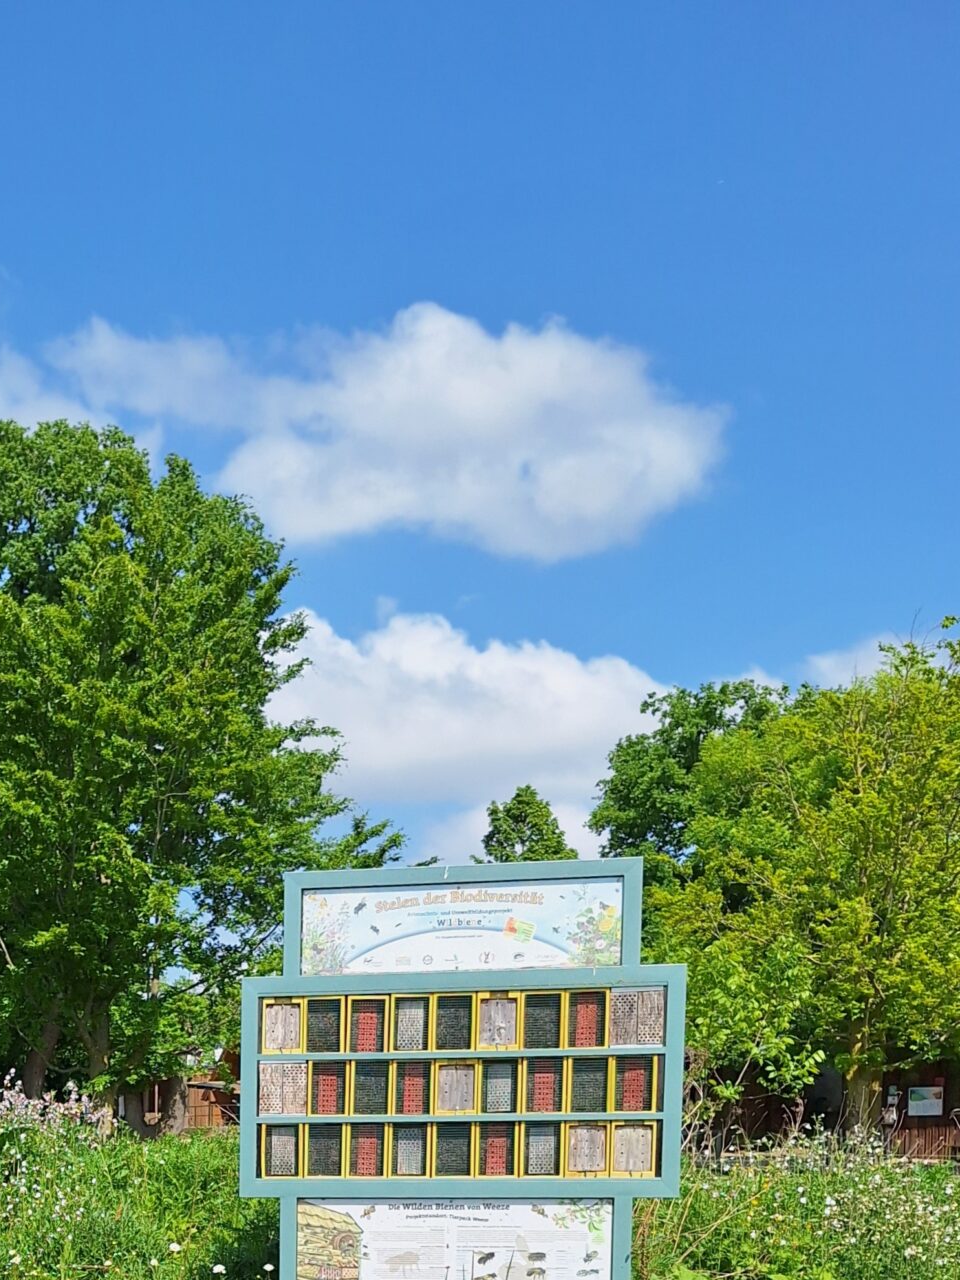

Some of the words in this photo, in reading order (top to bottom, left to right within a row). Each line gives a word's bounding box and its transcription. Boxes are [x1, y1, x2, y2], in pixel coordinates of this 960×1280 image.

[375, 896, 420, 913] Stelen
[423, 893, 447, 905] der
[450, 890, 544, 905] Biodiversität
[402, 1202, 433, 1210] Wilden
